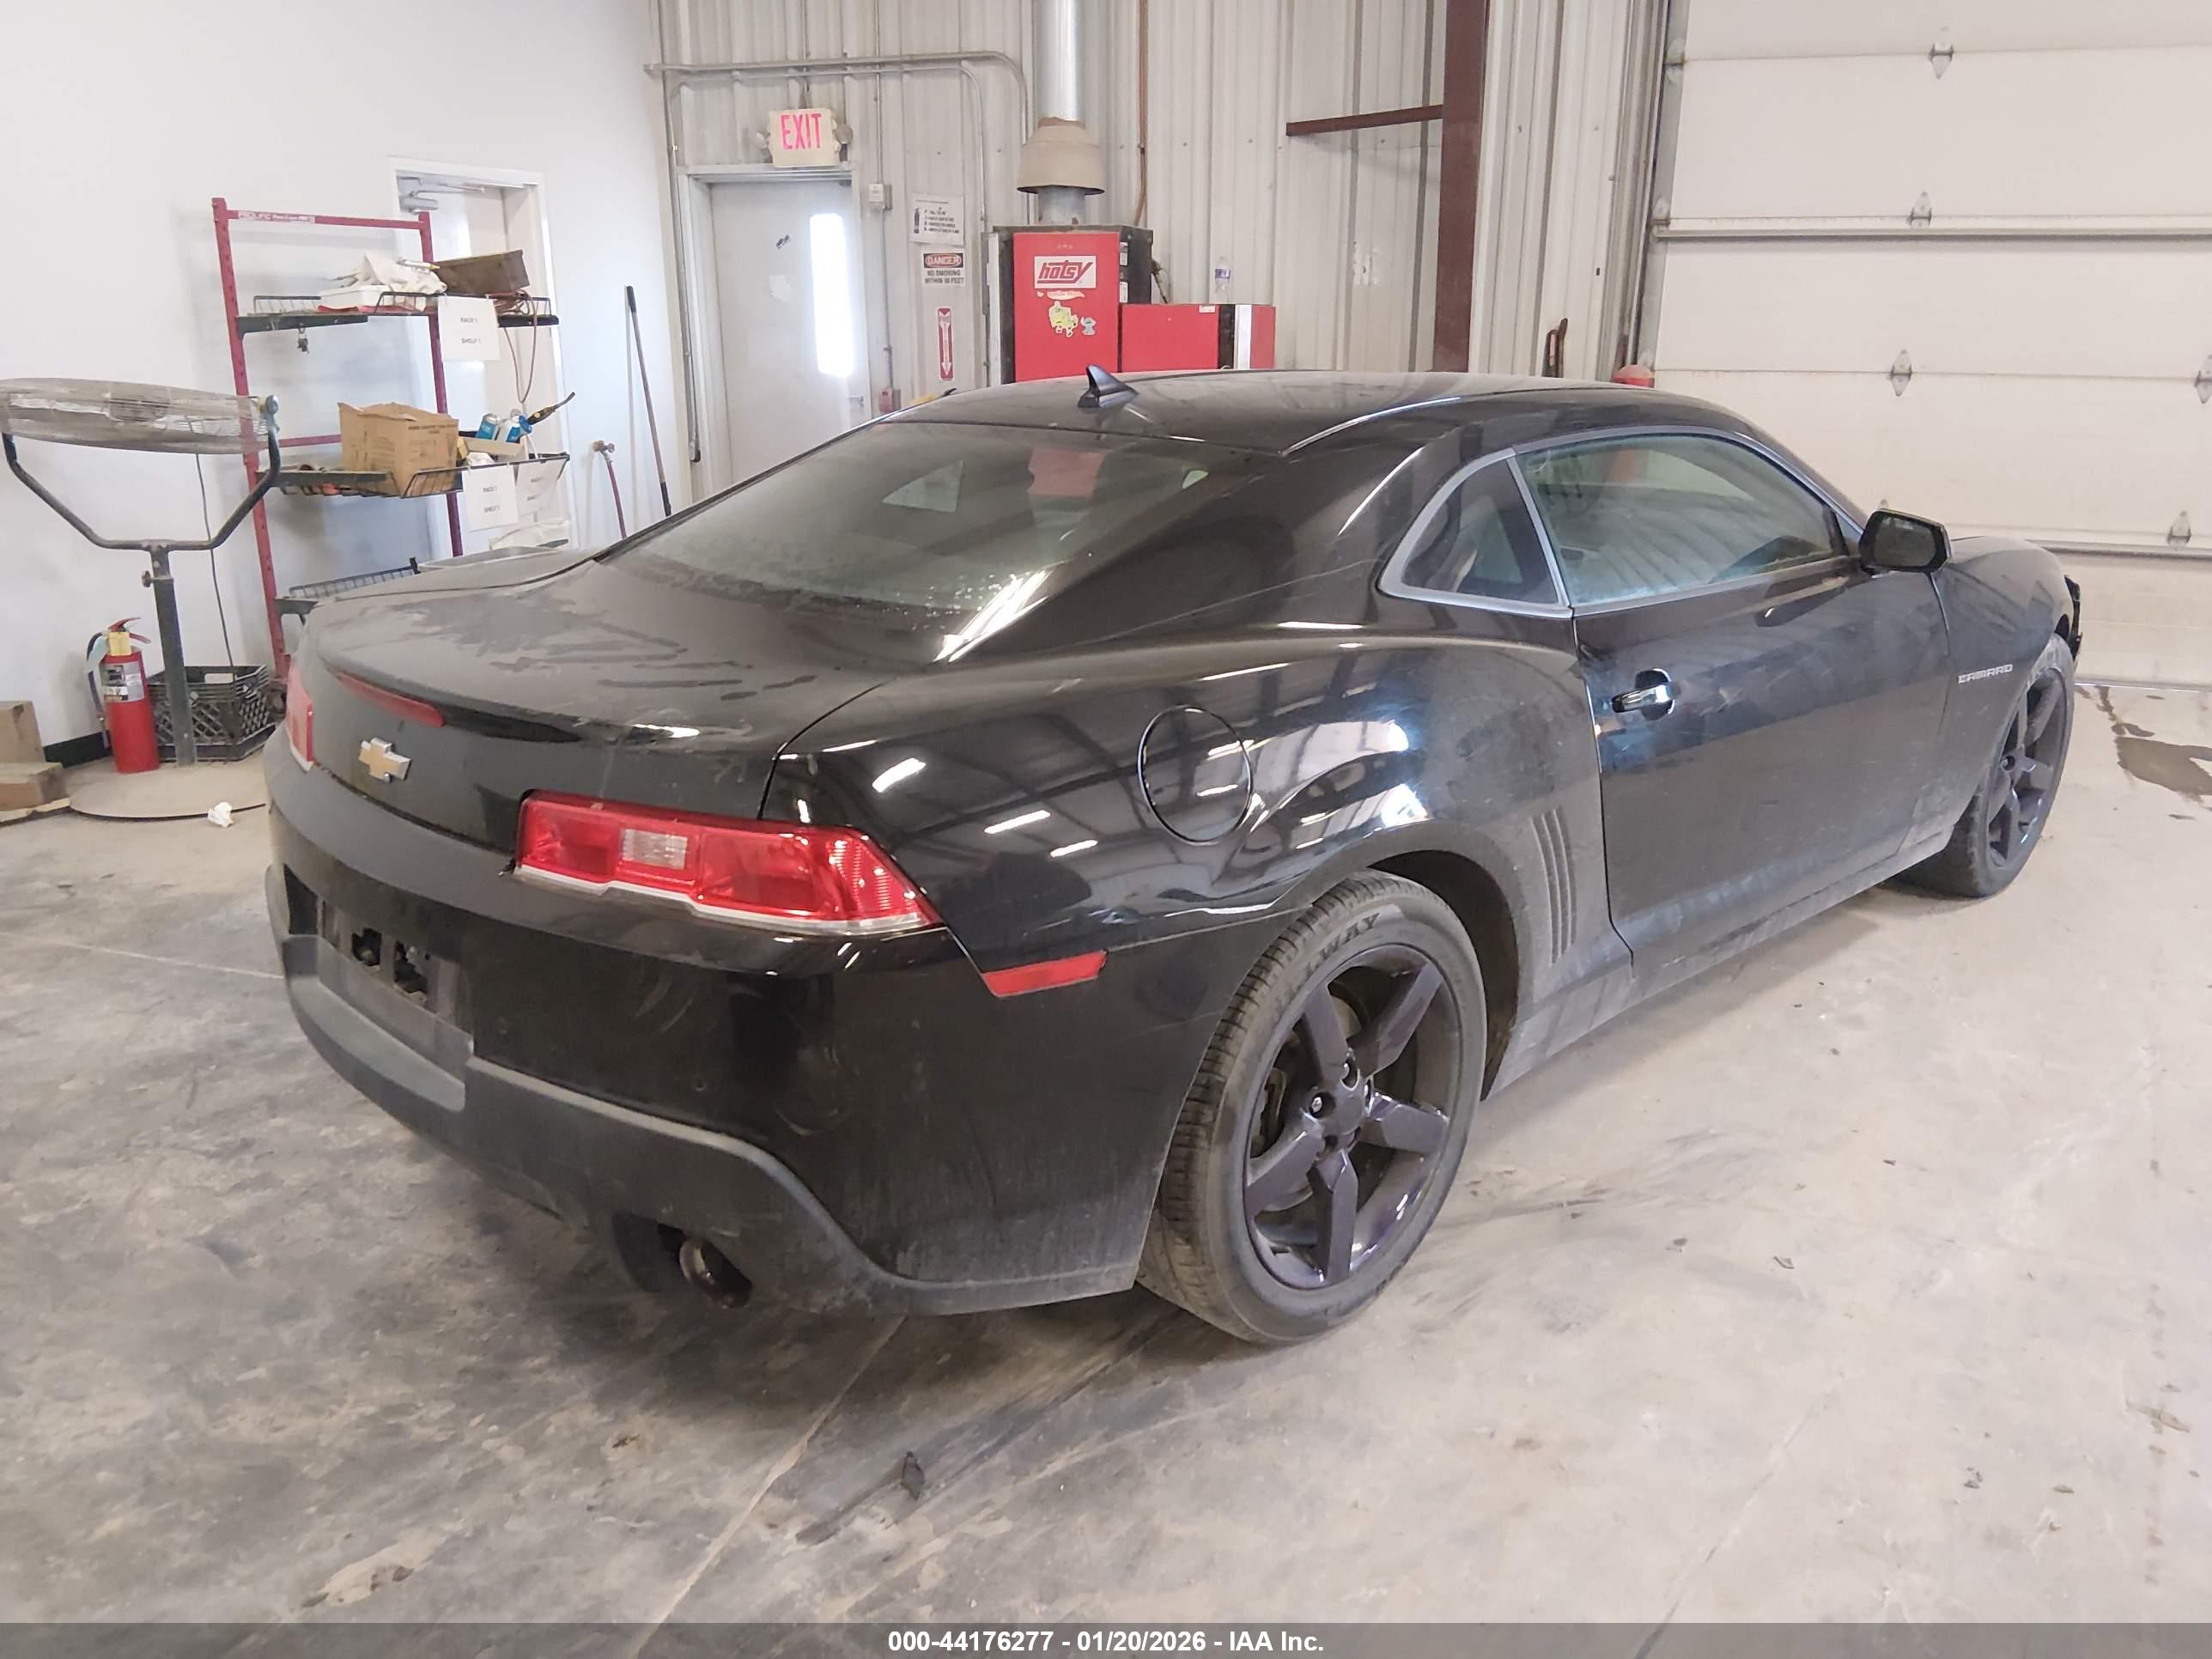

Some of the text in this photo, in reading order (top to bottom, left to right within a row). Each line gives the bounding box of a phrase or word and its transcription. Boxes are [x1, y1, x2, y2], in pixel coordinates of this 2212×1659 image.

[781, 113, 822, 149] EXIT
[927, 256, 960, 264] DANGER
[1037, 260, 1093, 284] hotsy
[1958, 664, 2013, 684] CAMARO
